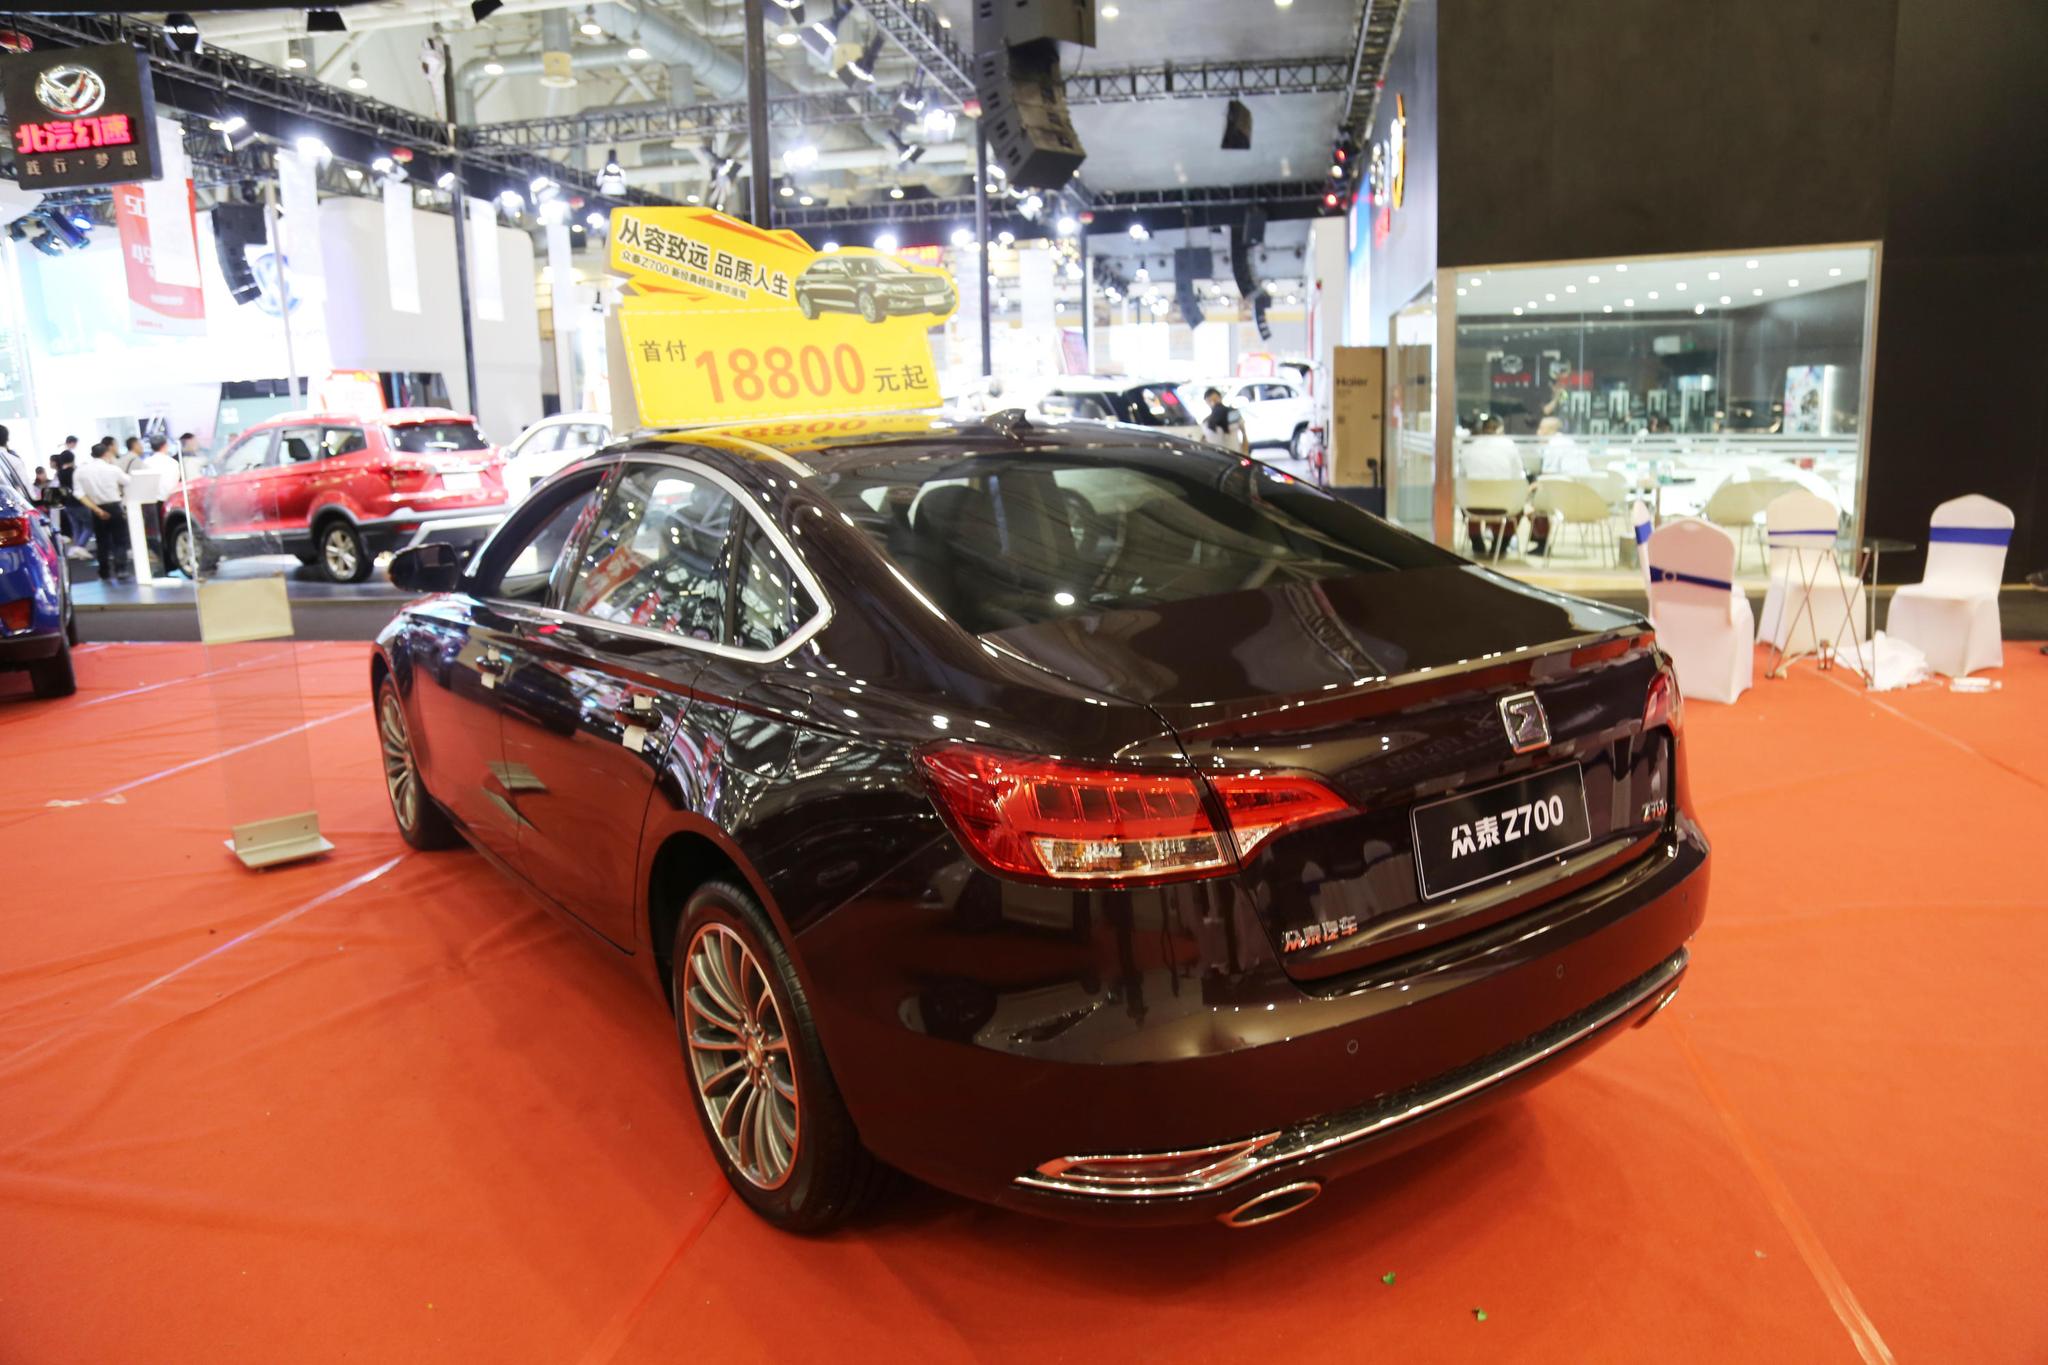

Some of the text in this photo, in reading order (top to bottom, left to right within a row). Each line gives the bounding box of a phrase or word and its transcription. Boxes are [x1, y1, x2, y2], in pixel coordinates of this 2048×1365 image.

[16, 114, 131, 154] 北汽幻速
[618, 218, 788, 298] 从容致远 品质人生
[639, 339, 929, 404] 首付 18800 元起
